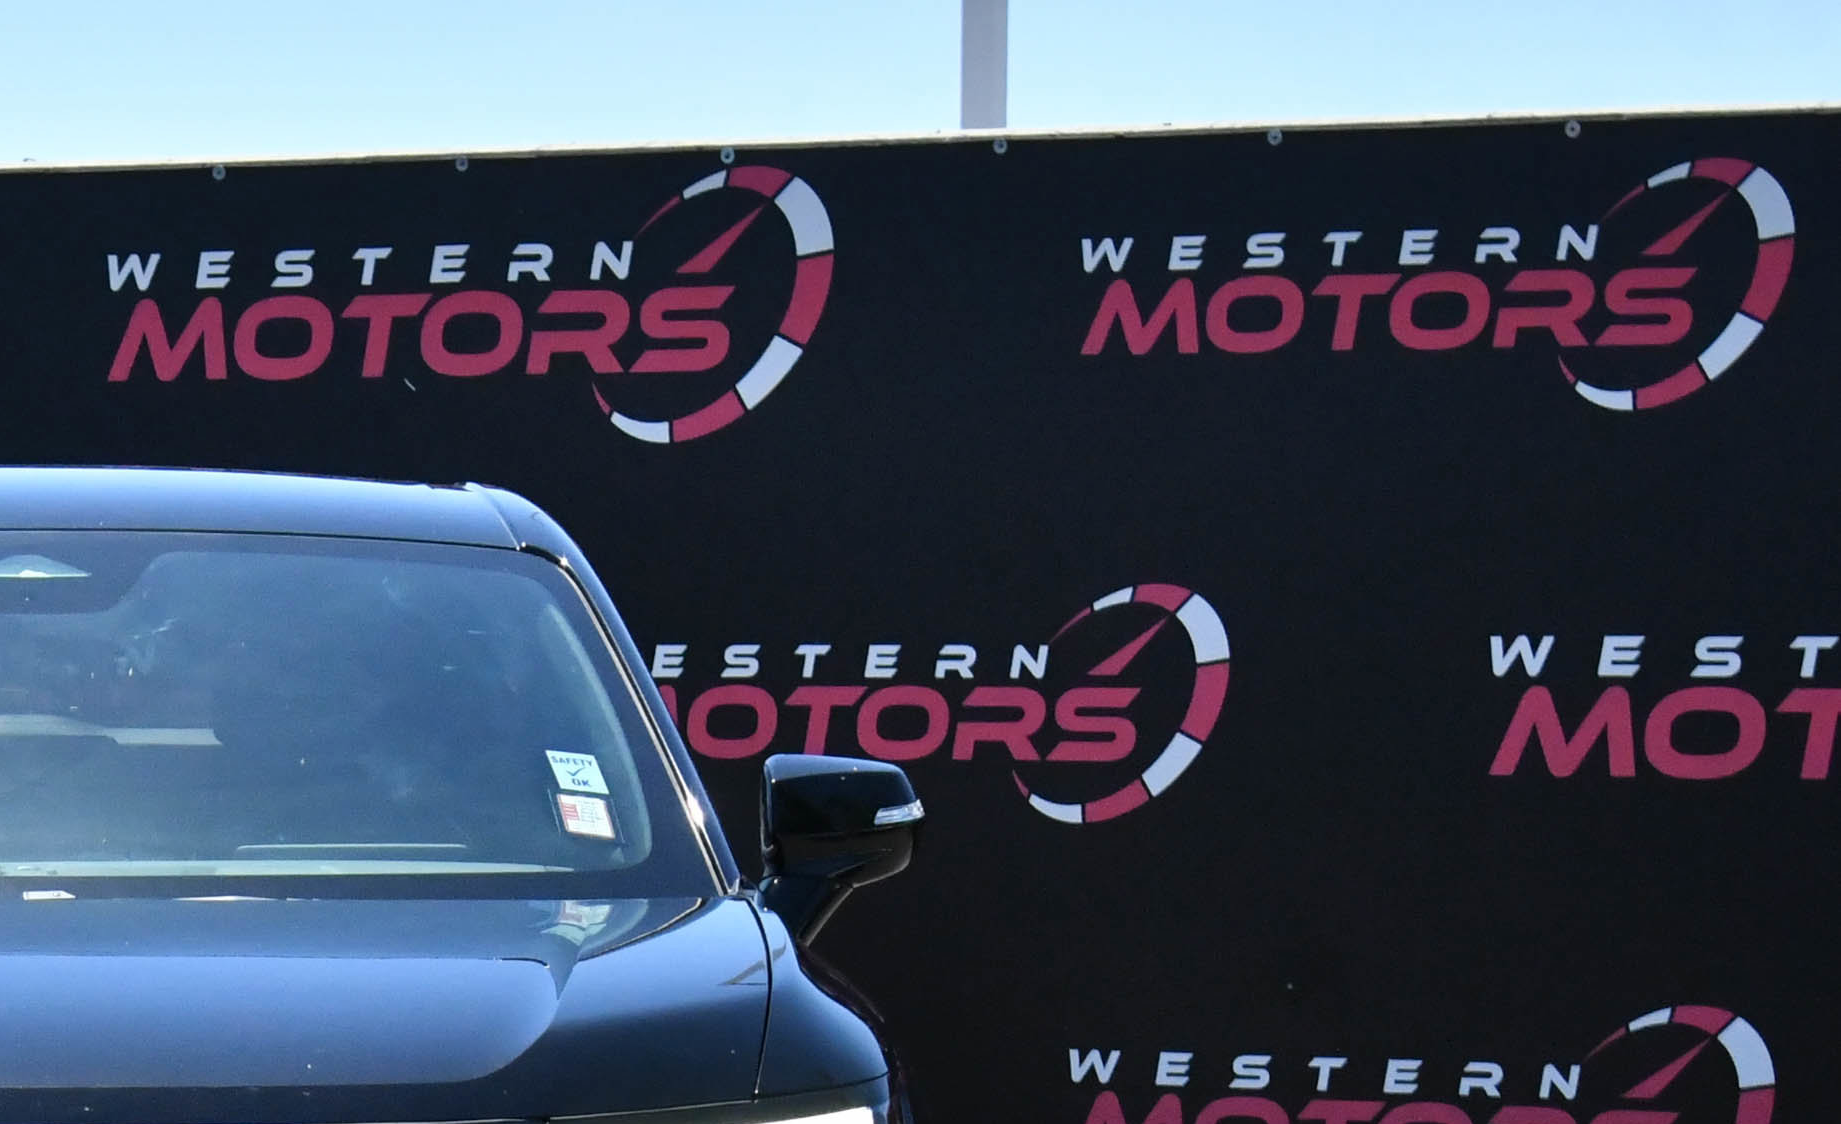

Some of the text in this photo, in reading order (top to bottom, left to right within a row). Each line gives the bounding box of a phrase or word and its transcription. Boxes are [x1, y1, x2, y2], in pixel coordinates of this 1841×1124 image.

[106, 239, 635, 293] WESTERN
[1080, 223, 1600, 274] WESTERN
[108, 284, 737, 383] MOTORS
[1081, 266, 1697, 357] MOTORS
[651, 643, 1050, 680] ESTERN
[1488, 633, 1840, 679] WEST
[1489, 684, 1841, 781] MOT
[551, 756, 592, 767] SAFETY
[572, 778, 590, 787] OK
[1067, 1047, 1582, 1101] WESTERN
